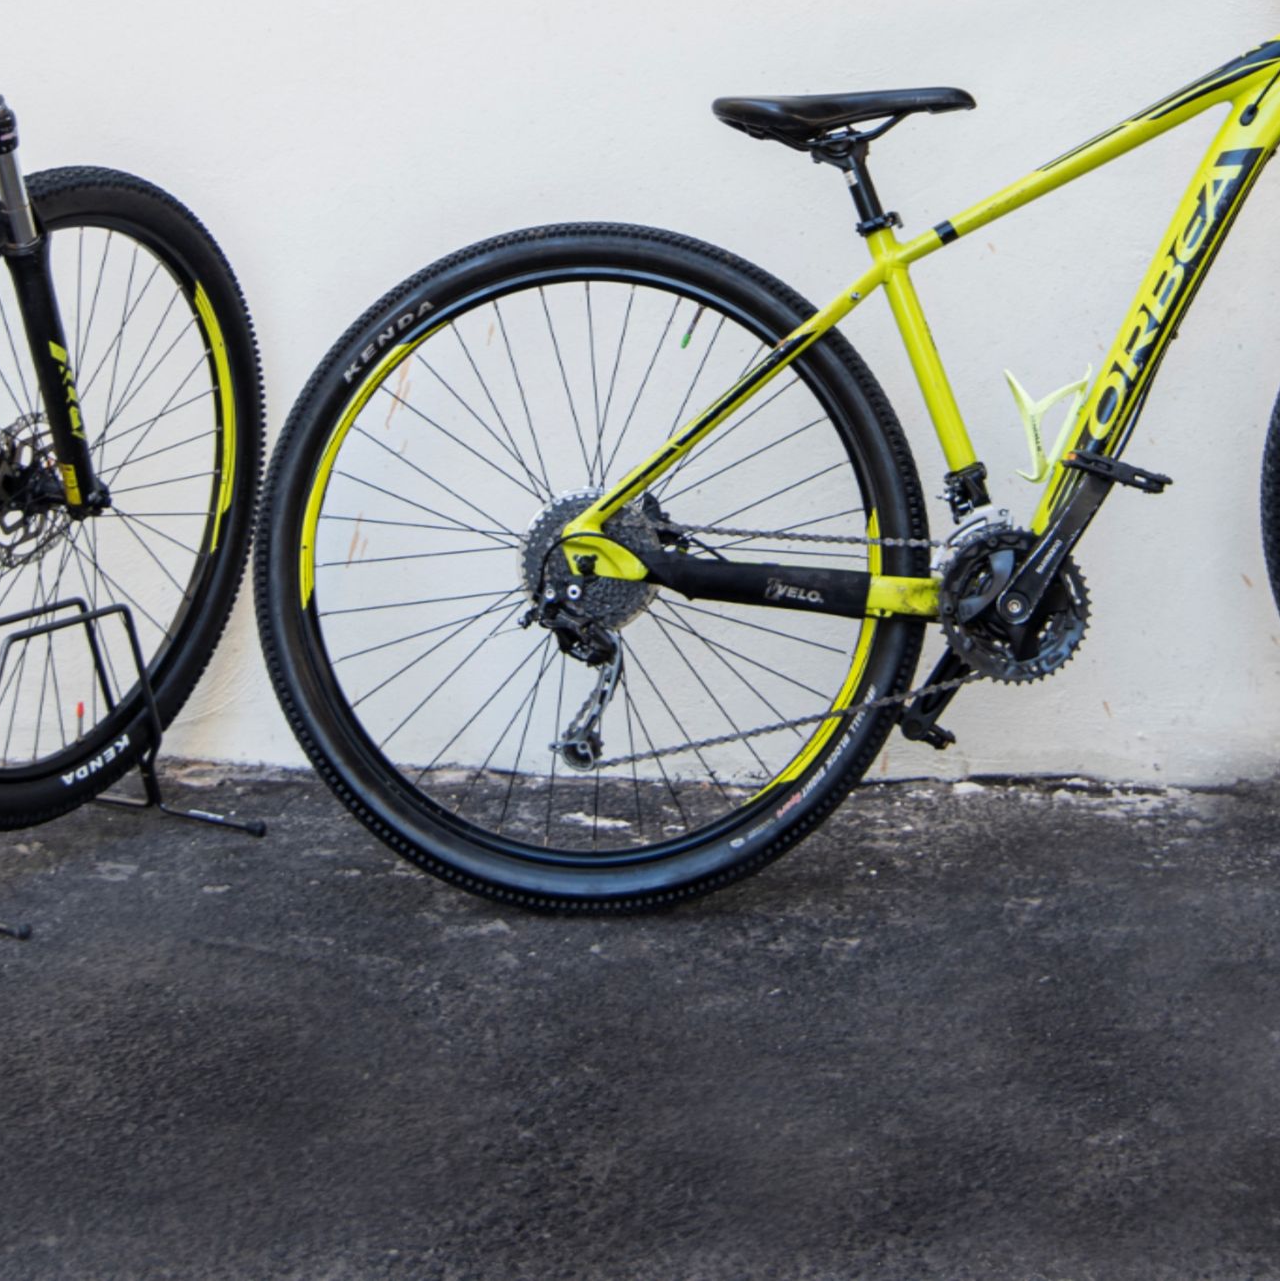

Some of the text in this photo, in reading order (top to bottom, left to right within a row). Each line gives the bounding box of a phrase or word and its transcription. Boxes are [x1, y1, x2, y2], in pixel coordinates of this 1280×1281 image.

[343, 301, 434, 383] KENDA
[1088, 164, 1244, 440] ORBEA
[61, 733, 130, 786] KENDA
